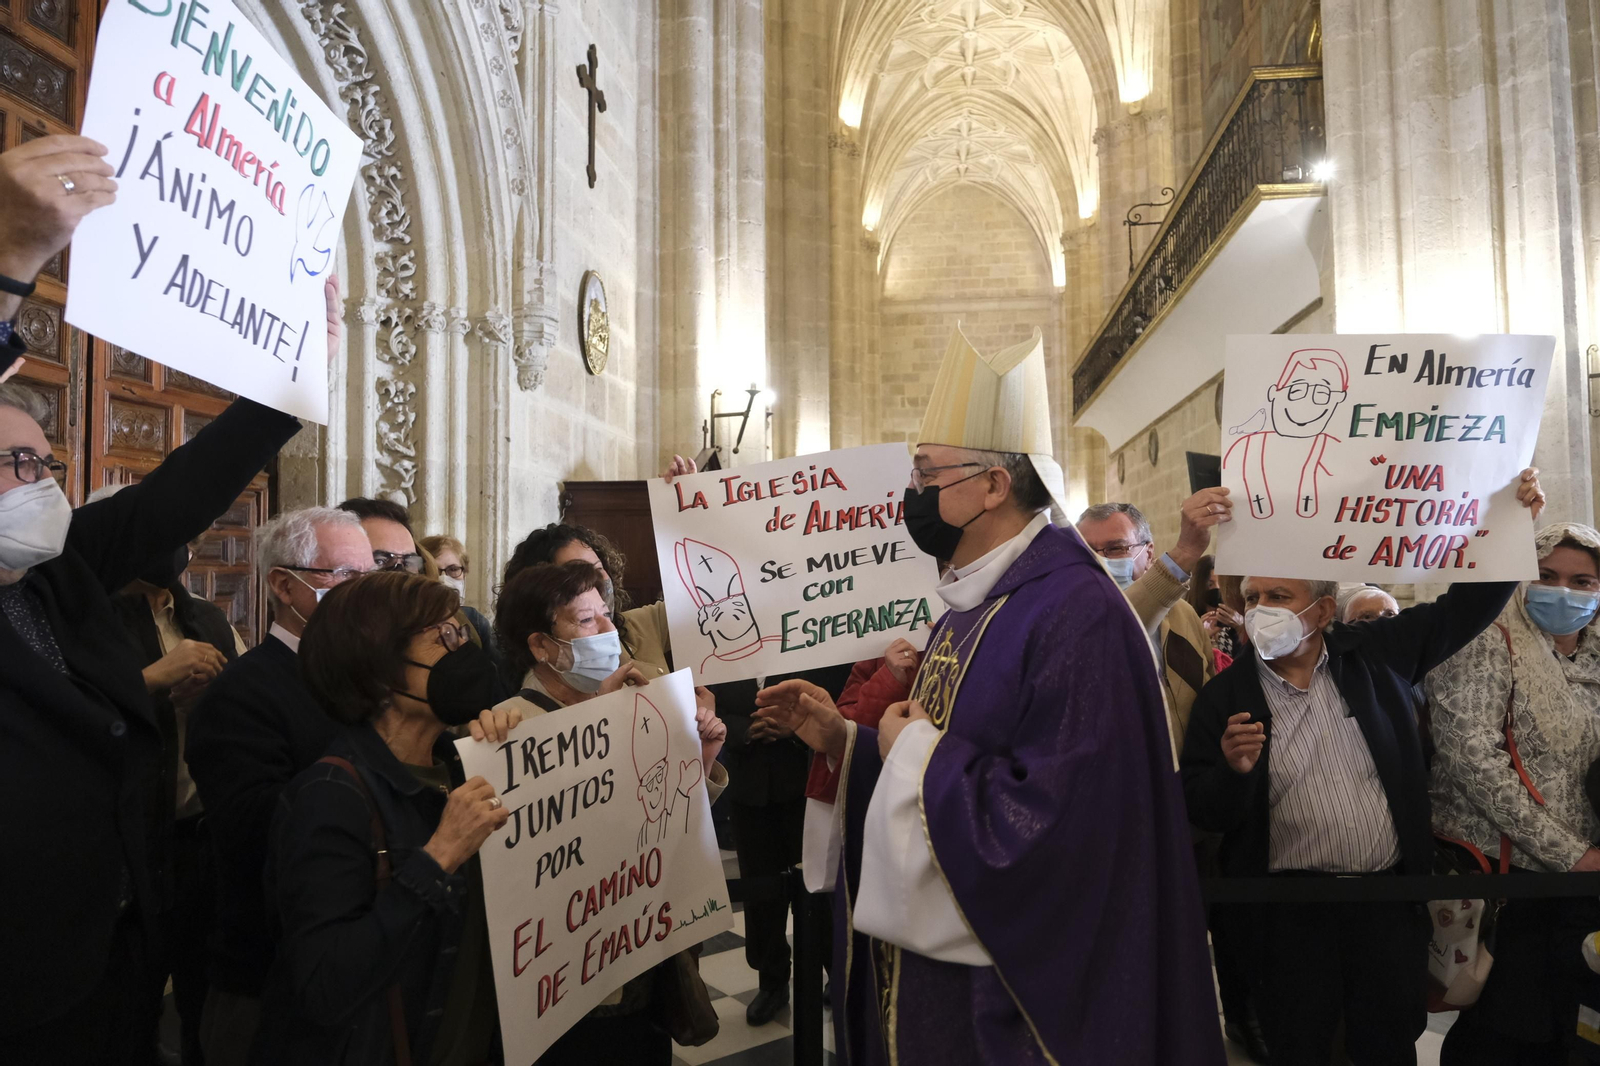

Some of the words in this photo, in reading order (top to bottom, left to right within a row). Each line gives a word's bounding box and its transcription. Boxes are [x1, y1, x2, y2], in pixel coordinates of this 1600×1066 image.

[127, 0, 330, 177] IENVENIDO
[184, 92, 287, 216] Almería
[163, 254, 309, 383] ADELANTE!
[1413, 349, 1535, 388] Almería
[674, 482, 708, 512] LA
[766, 506, 796, 532] de
[760, 560, 797, 582] SE
[806, 541, 916, 574] MUEVE
[1323, 535, 1357, 560] de
[803, 575, 854, 602] con
[780, 598, 932, 653] ESPERANZA
[496, 717, 610, 796] IREMOS
[504, 768, 615, 849] JUNTOS
[535, 836, 585, 889] POR
[513, 917, 553, 977] EL
[537, 960, 571, 1019] DE
[581, 900, 673, 985] EMAÚS
